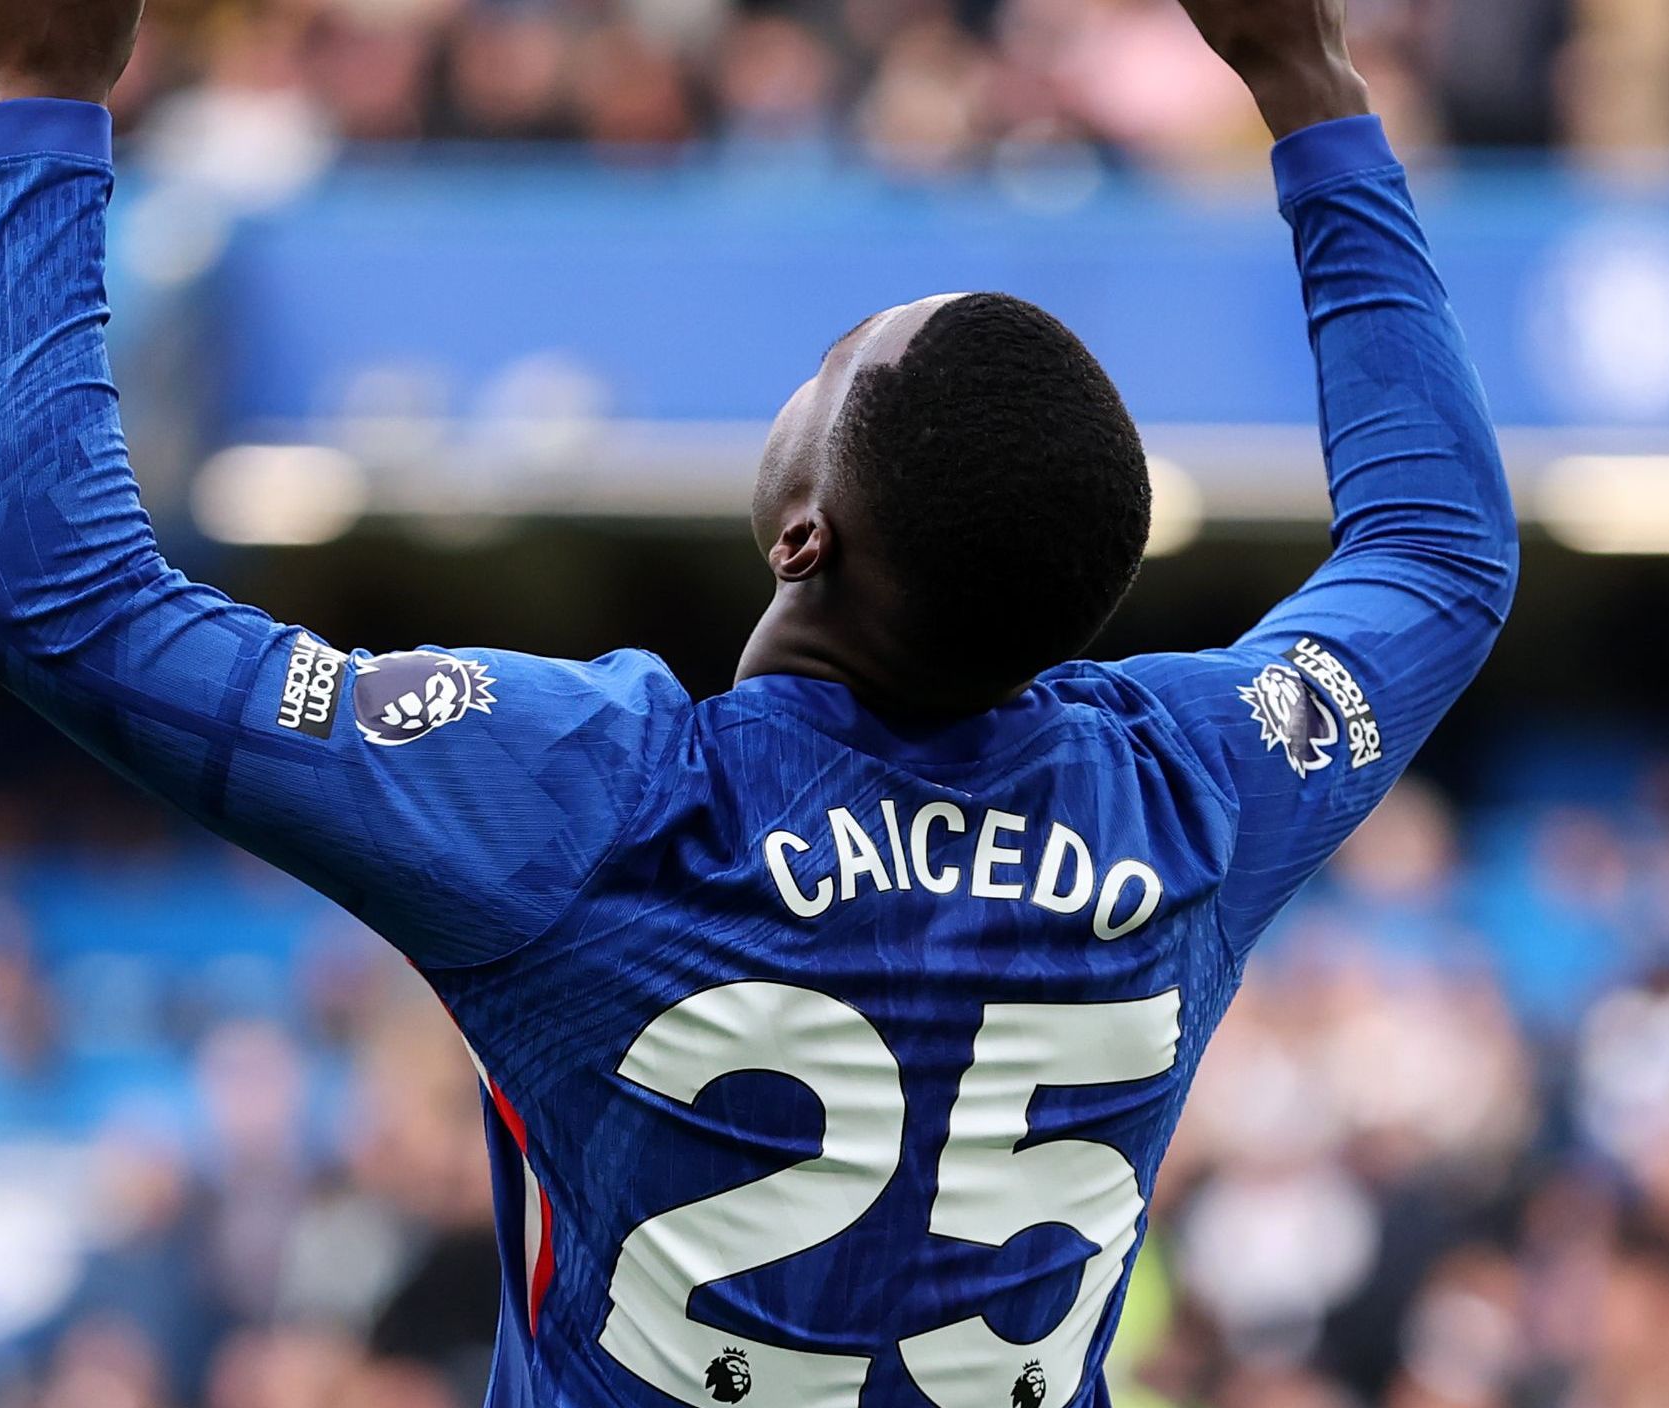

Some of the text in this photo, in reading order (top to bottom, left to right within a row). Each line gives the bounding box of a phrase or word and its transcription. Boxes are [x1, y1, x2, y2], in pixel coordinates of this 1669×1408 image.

[1293, 654, 1369, 769] No room
[1295, 637, 1370, 714] racism
[764, 799, 1163, 941] CAICEDO
